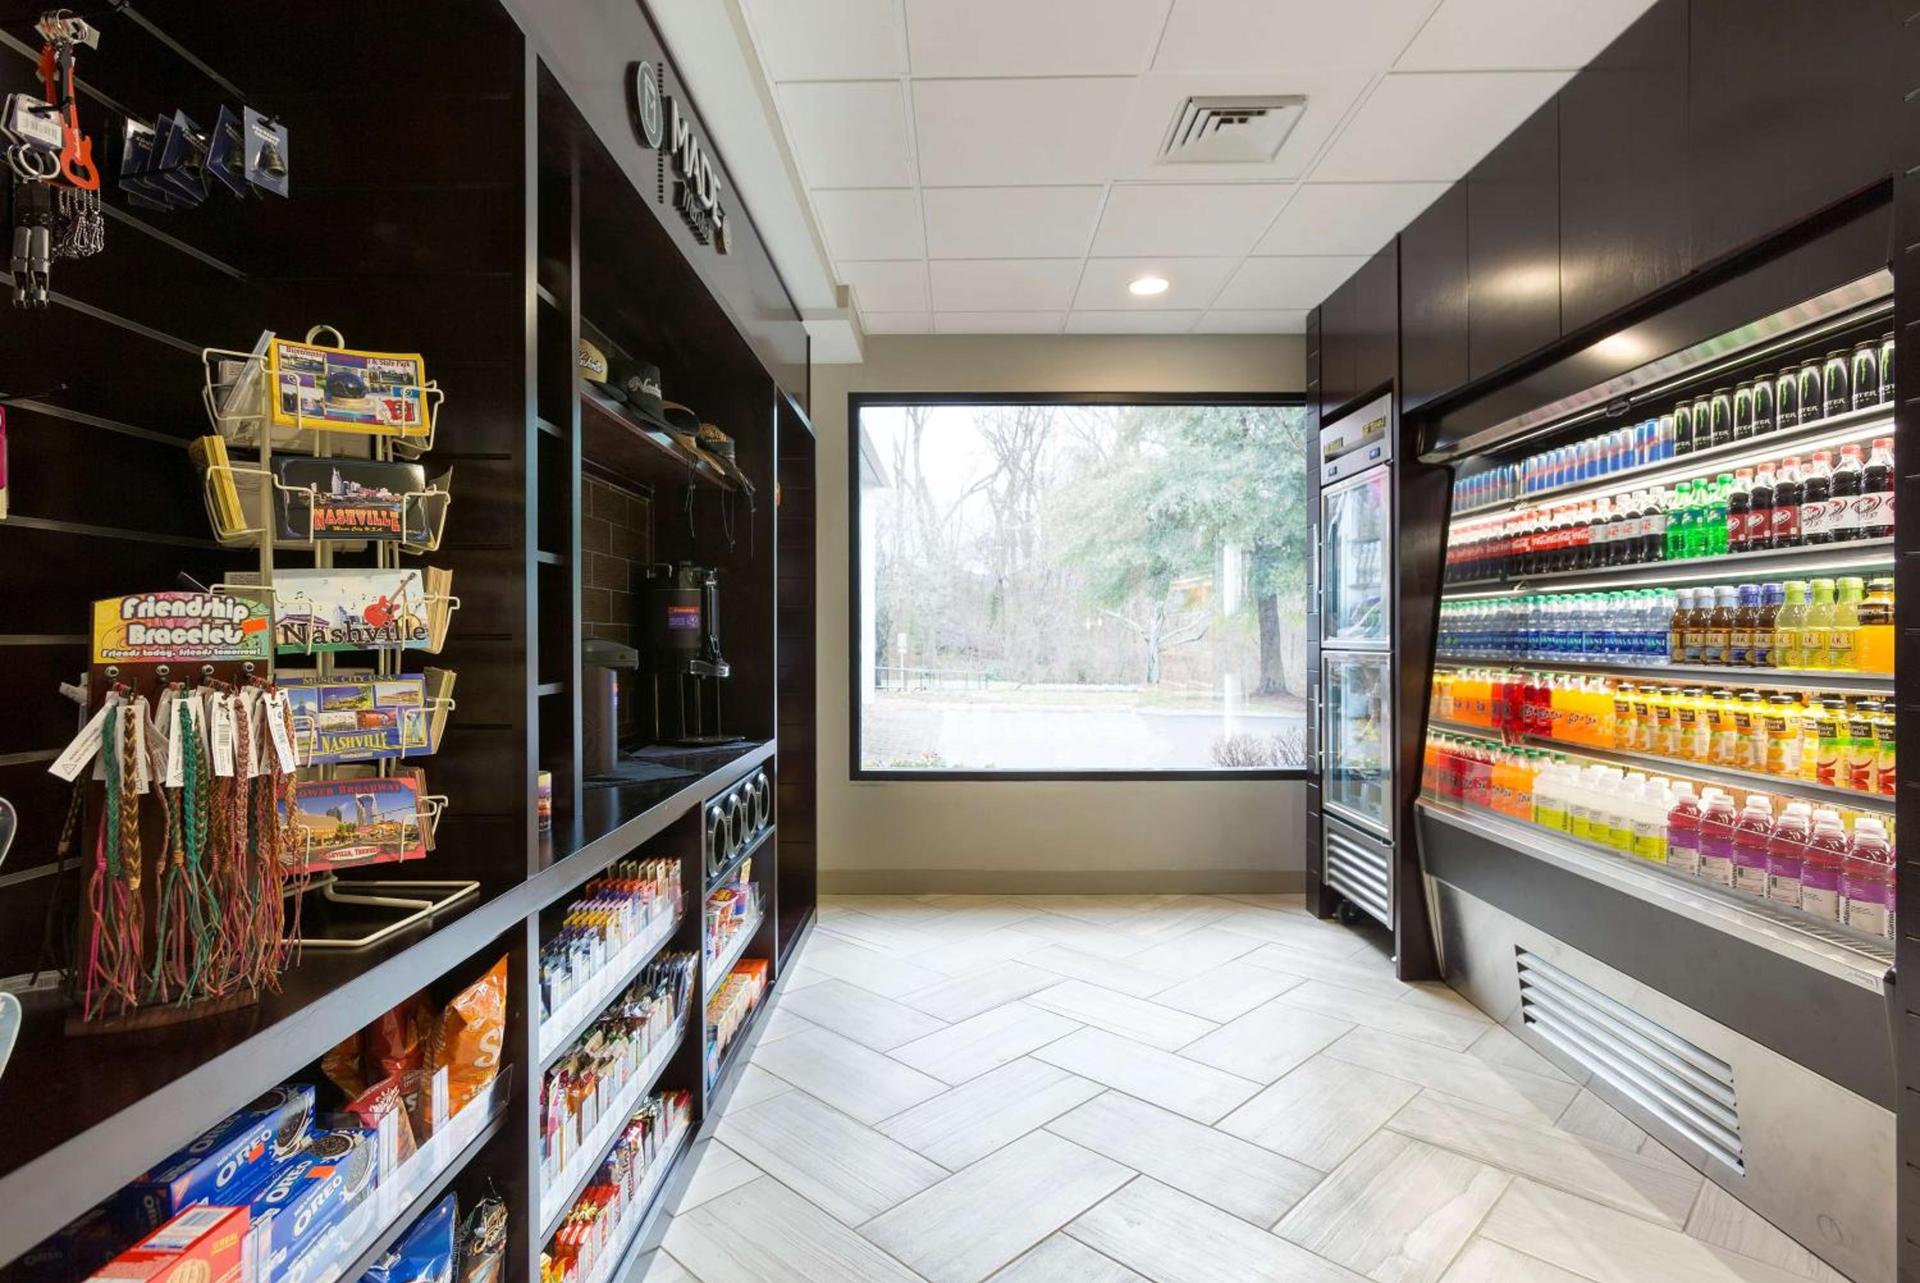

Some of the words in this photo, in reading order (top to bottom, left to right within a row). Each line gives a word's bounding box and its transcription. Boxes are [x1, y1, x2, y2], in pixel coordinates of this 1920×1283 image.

[314, 507, 401, 533] NASHVILLE
[121, 594, 251, 624] Friendship
[127, 622, 244, 646] Bracelets
[280, 620, 426, 646] Nashville
[102, 649, 140, 658] Friends
[179, 648, 212, 657] friends
[214, 647, 261, 656] tomorrow!
[321, 732, 388, 754] NASHVILLE
[298, 786, 335, 799] OWER
[338, 781, 402, 794] BROADWAY
[215, 1128, 272, 1188] OREO
[266, 1160, 313, 1203] OREO
[293, 1175, 343, 1238] OREO
